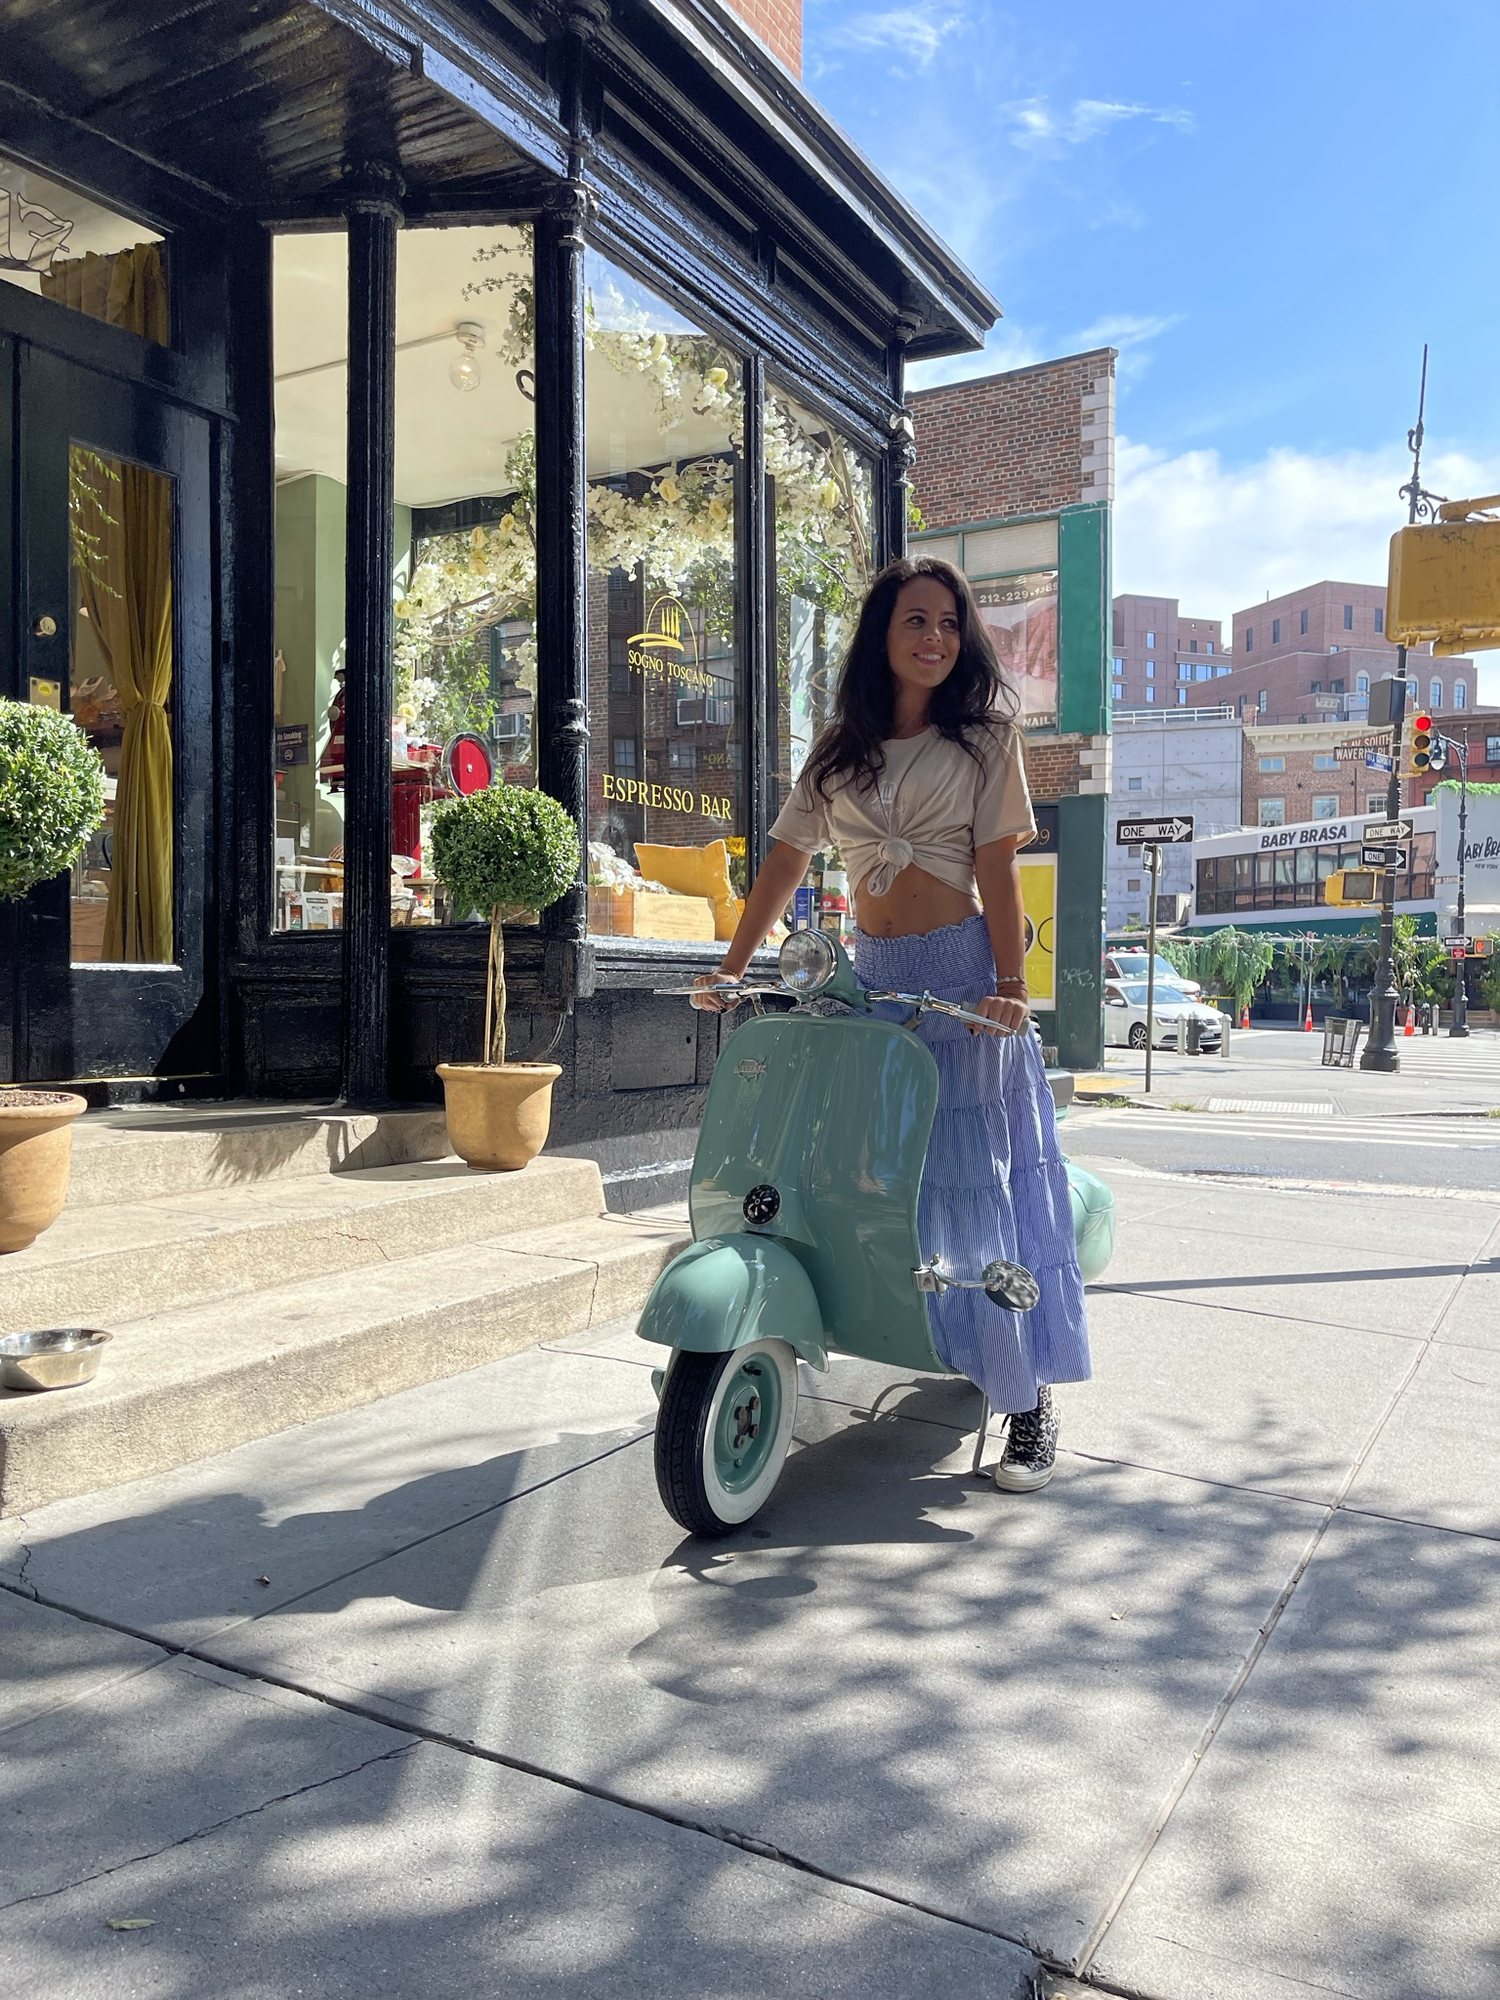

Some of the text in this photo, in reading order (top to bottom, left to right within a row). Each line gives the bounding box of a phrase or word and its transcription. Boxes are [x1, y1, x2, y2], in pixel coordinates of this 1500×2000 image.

[628, 650, 713, 688] SOGNO TOSCANO
[1364, 734, 1391, 747] SOUTH
[602, 773, 732, 820] ESPRESSO BAR
[1123, 824, 1182, 837] ONE WAY
[1261, 825, 1347, 848] BABY BRASA
[1369, 826, 1405, 837] ONE WAY
[1367, 852, 1381, 861] ONE
